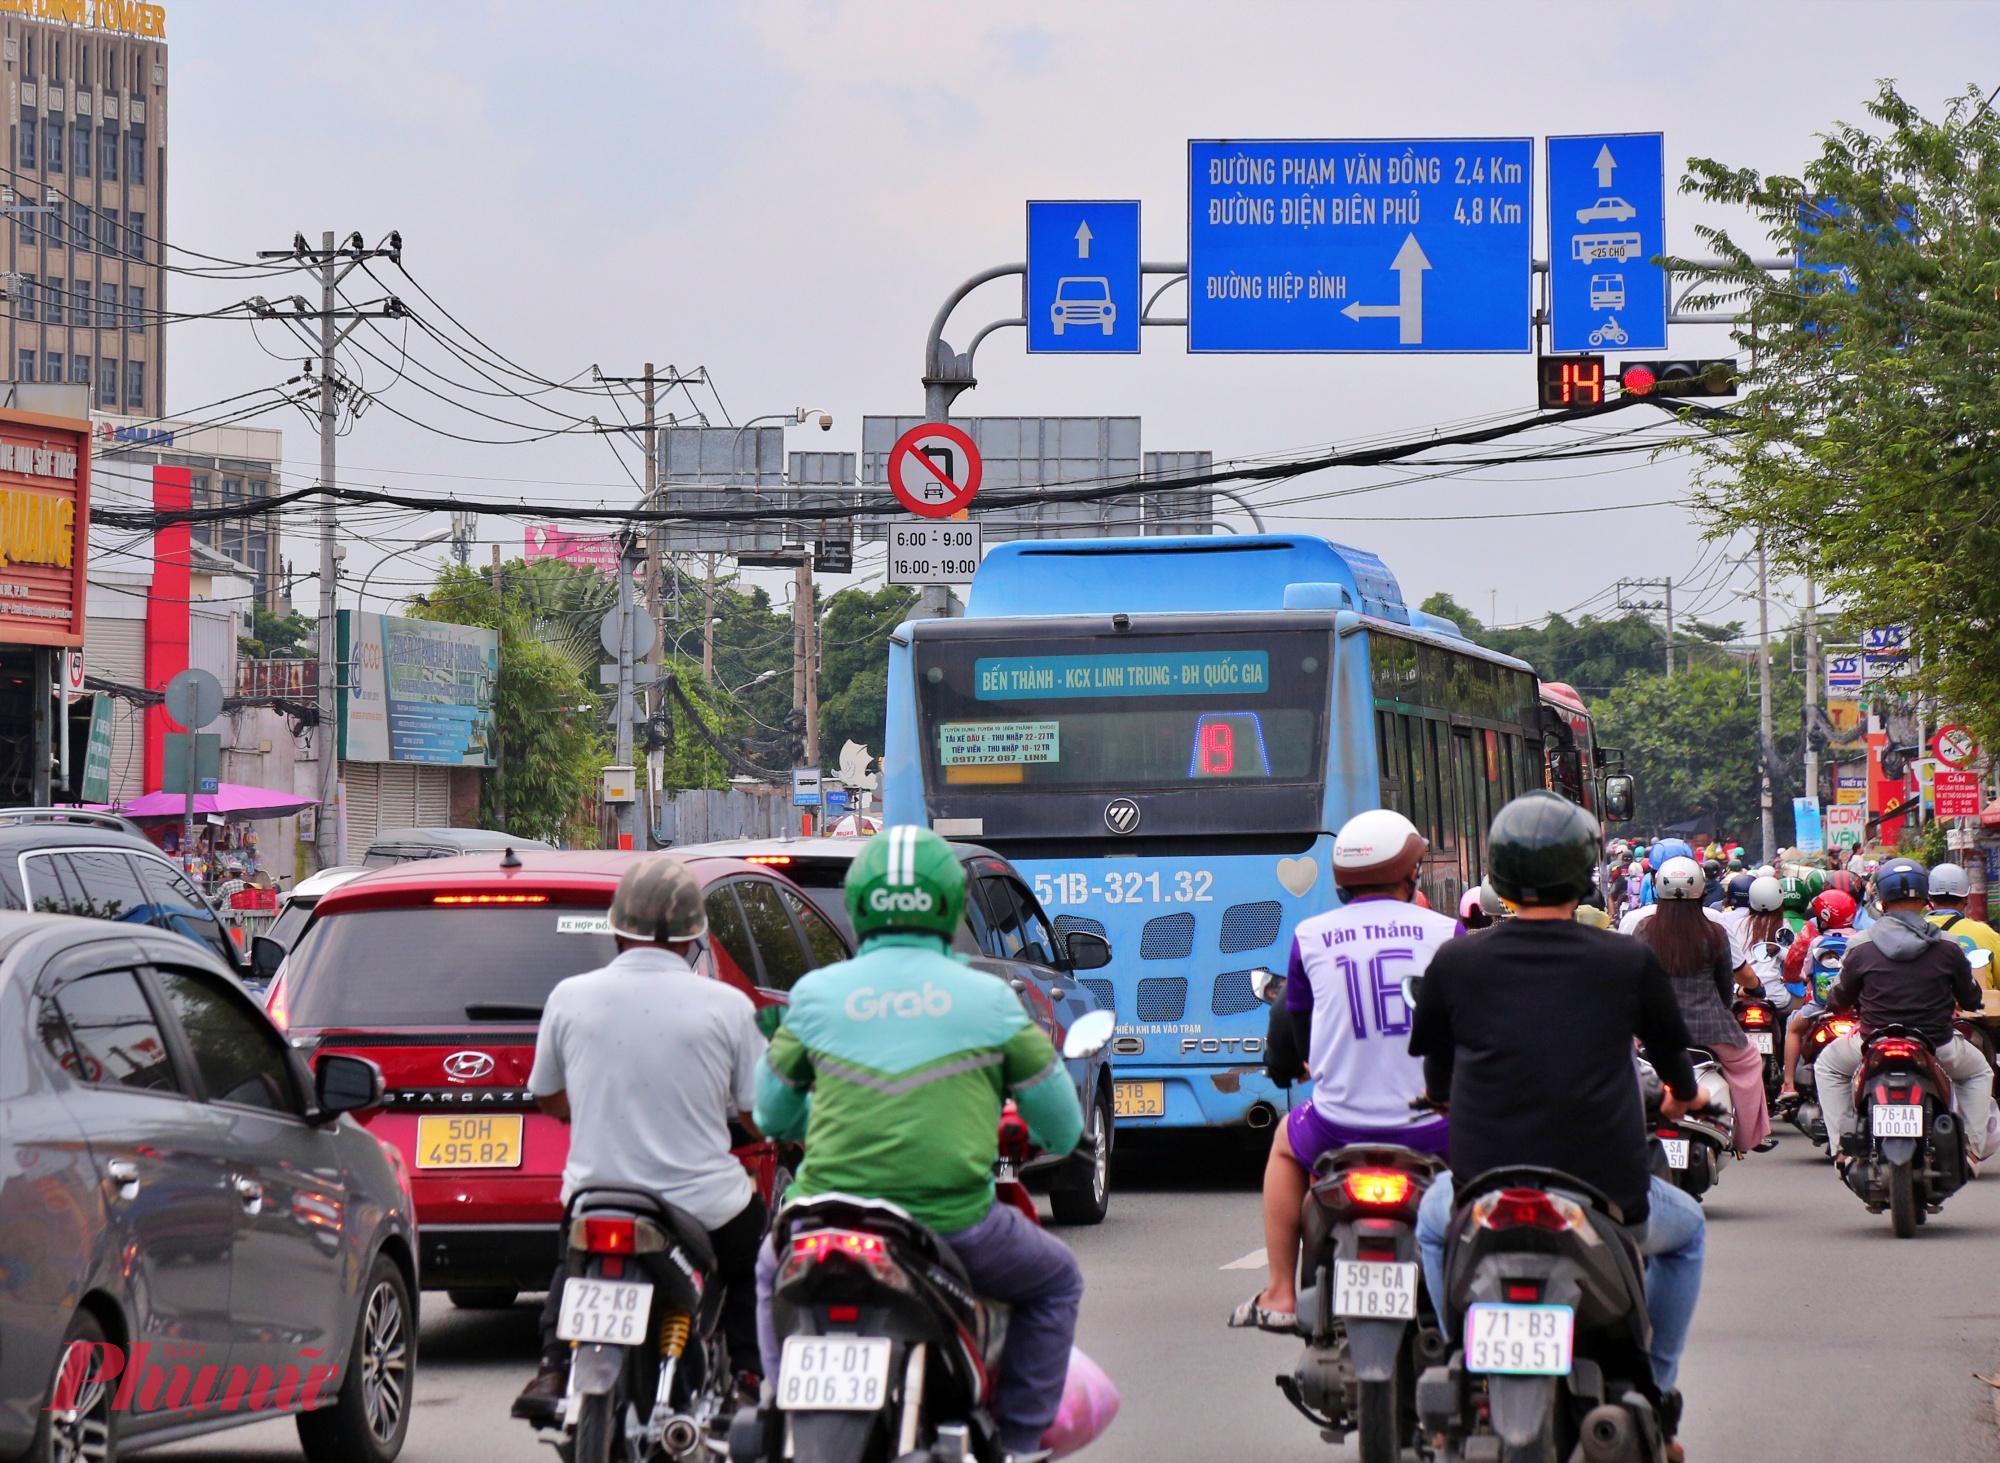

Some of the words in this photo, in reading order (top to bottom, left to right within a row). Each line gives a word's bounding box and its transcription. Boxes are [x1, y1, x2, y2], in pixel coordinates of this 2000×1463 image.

[94, 0, 166, 39] TOWER
[1209, 152, 1275, 185] ĐƯỜNG
[1282, 158, 1335, 189] PHẠM
[1344, 153, 1381, 184] VĂN
[1387, 147, 1441, 184] ĐỒNG
[1455, 157, 1484, 186] 2,4
[1490, 157, 1522, 184] Km
[1208, 191, 1275, 225] ĐƯỜNG
[1280, 193, 1325, 230] ĐIỆN
[1332, 193, 1376, 225] BIÊN
[1383, 189, 1420, 225] PHỦ
[1454, 197, 1483, 226] 4,8
[1490, 197, 1521, 224] Km
[1206, 270, 1262, 299] ĐƯỜNG
[1267, 271, 1304, 304] HIỆP
[1309, 269, 1346, 299] BÌNH
[1562, 364, 1599, 402] 14
[897, 532, 926, 546] 6:00
[943, 532, 973, 546] 9:00
[894, 560, 929, 574] 16:00
[941, 560, 976, 574] 19:00
[982, 664, 1008, 691] BẾN
[1011, 665, 1054, 690] THÀNH
[1065, 668, 1091, 688] KCX
[1095, 667, 1124, 687] LINH
[1127, 665, 1170, 686] TRUNG
[1182, 664, 1200, 684] ĐH
[1203, 656, 1239, 687] QUỐC
[1241, 664, 1263, 683] GIA
[987, 745, 1000, 753] THU
[1001, 744, 1019, 754] NHẬP
[1021, 744, 1029, 752] 10
[1042, 743, 1050, 751] TR
[1006, 732, 1024, 743] NHẬP
[1025, 733, 1034, 741] 22
[1046, 732, 1055, 740] TR
[1202, 724, 1233, 773] 19
[952, 755, 976, 763] 0917
[1024, 753, 1048, 761] LINH
[870, 887, 933, 912] Grab
[1034, 870, 1214, 906] 51B-321.32
[561, 921, 572, 929] XE
[575, 920, 593, 931] HỢP
[1321, 926, 1357, 948] Văn
[1362, 920, 1424, 941] Thắng
[845, 981, 952, 1022] Grab
[1336, 949, 1414, 1040] 16
[1136, 1025, 1149, 1034] KHI
[1151, 1025, 1161, 1034] RA
[1163, 1022, 1178, 1034] VÀO
[1180, 1024, 1202, 1035] TRẠM
[383, 1092, 534, 1102] STARGAZE
[1115, 1084, 1144, 1099] 51B
[1114, 1100, 1156, 1114] 21.32
[1881, 1108, 1915, 1121] 76-AA
[448, 1119, 492, 1140] 50H
[1877, 1121, 1918, 1135] 100.01
[429, 1143, 509, 1164] 495.82
[1347, 1264, 1404, 1289] 59-GA
[577, 1283, 639, 1312] 72-K8
[1342, 1289, 1409, 1315] 118.92
[571, 1312, 634, 1339] 9126
[1486, 1311, 1556, 1338] 71-B3
[800, 1346, 870, 1371] 61-D1
[1475, 1342, 1561, 1368] 359.51
[787, 1376, 878, 1403] 806.38
